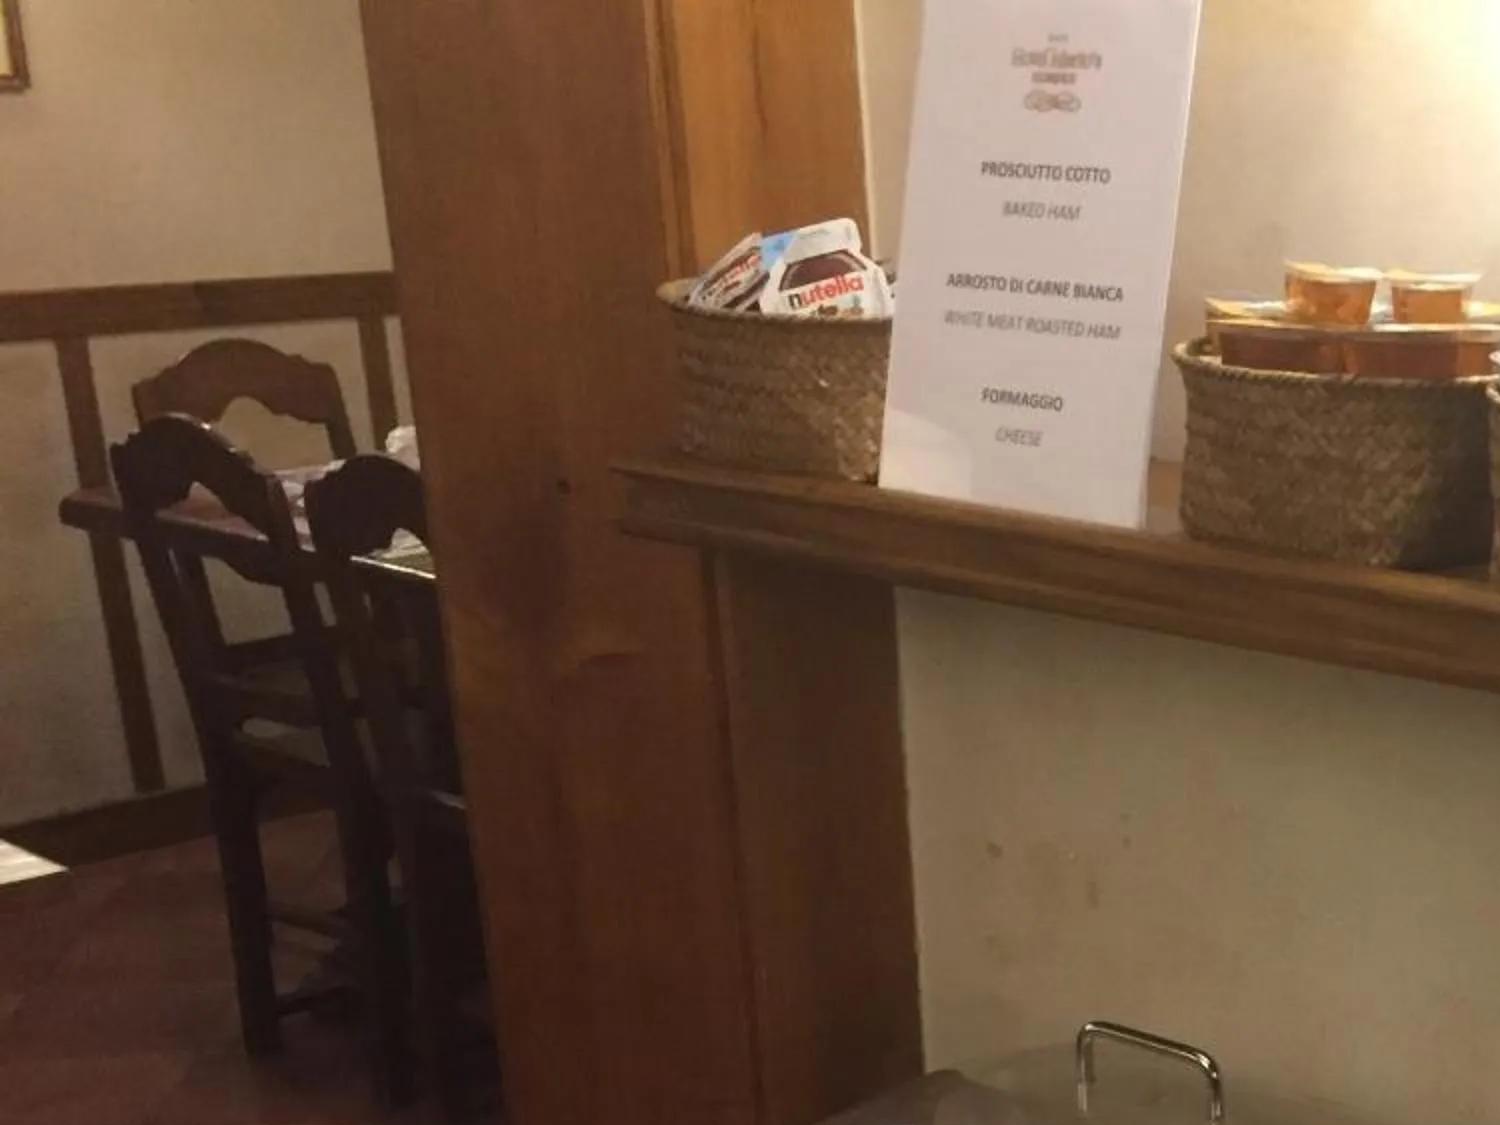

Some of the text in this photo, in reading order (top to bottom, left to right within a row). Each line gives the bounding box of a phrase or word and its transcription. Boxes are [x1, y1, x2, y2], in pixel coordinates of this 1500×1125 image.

[981, 161, 1111, 184] PROSCIUTTO COTTO
[1003, 201, 1082, 220] BAKED HAM
[788, 273, 864, 309] nutella
[946, 273, 1124, 301] ARROSTO DI CARNE BIANCA
[944, 310, 1121, 339] WHITE MEAT ROASTED HAM
[981, 387, 1063, 411] FORMAGGIO
[995, 426, 1044, 446] CHEESE
